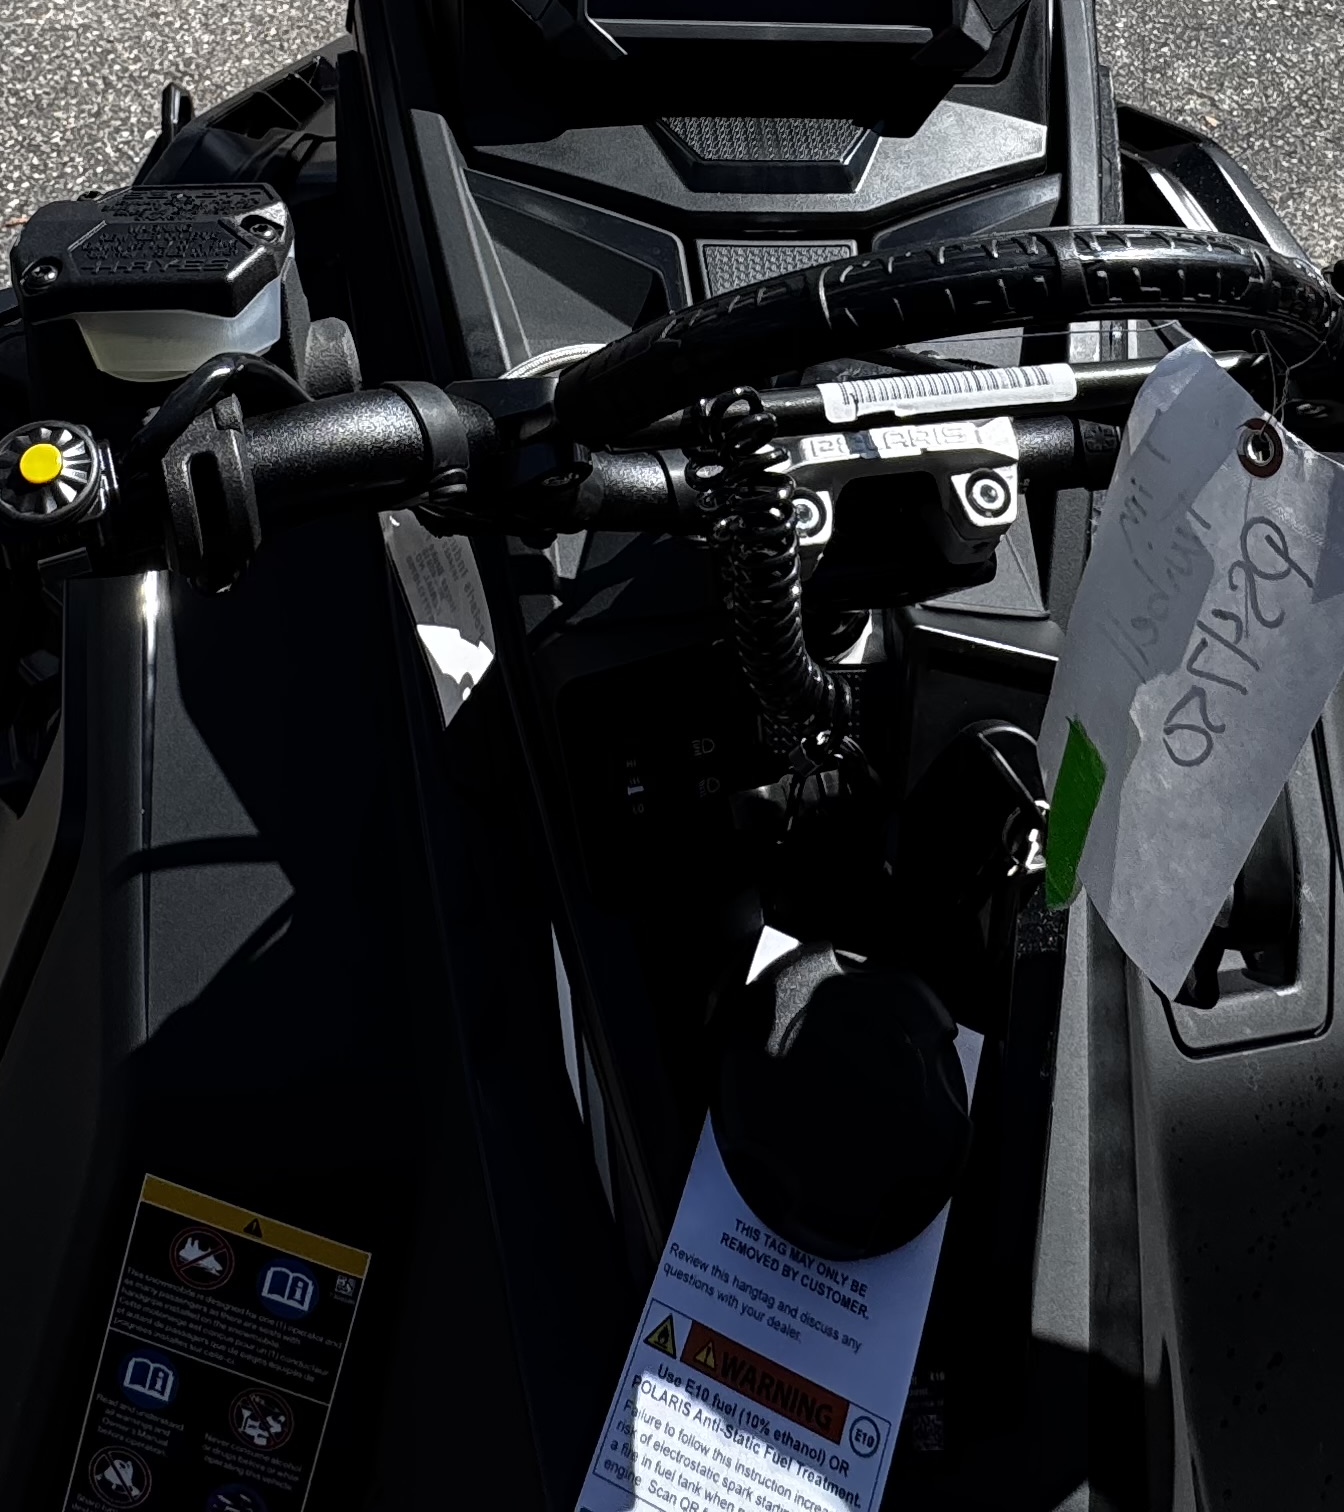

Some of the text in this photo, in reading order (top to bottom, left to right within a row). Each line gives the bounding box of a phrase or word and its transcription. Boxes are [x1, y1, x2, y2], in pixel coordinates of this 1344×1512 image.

[668, 1242, 862, 1355] Review this hangtag and discuss any
[719, 1231, 870, 1320] REMOVED BY CUSTOMER.
[735, 1219, 869, 1298] THIS TAG MAY ONLY BE
[663, 1262, 802, 1341] questions with your dealer.
[657, 1363, 850, 1478] Use E10 fuel (10% ethanol) OR
[719, 1352, 834, 1429] WARNING
[609, 1439, 736, 1512] a fire in fuel tank when
[615, 1419, 638, 1439] risk
[639, 1433, 653, 1447] of
[652, 1440, 720, 1484] electrostatic
[721, 1476, 754, 1502] spark
[622, 1400, 829, 1512] Failure to follow this instruction increa
[630, 1374, 862, 1510] POLARIS Anti-Static Fuel Treatment.
[854, 1427, 875, 1449] E10
[603, 1458, 642, 1488] engine
[647, 1478, 678, 1506] Scan
